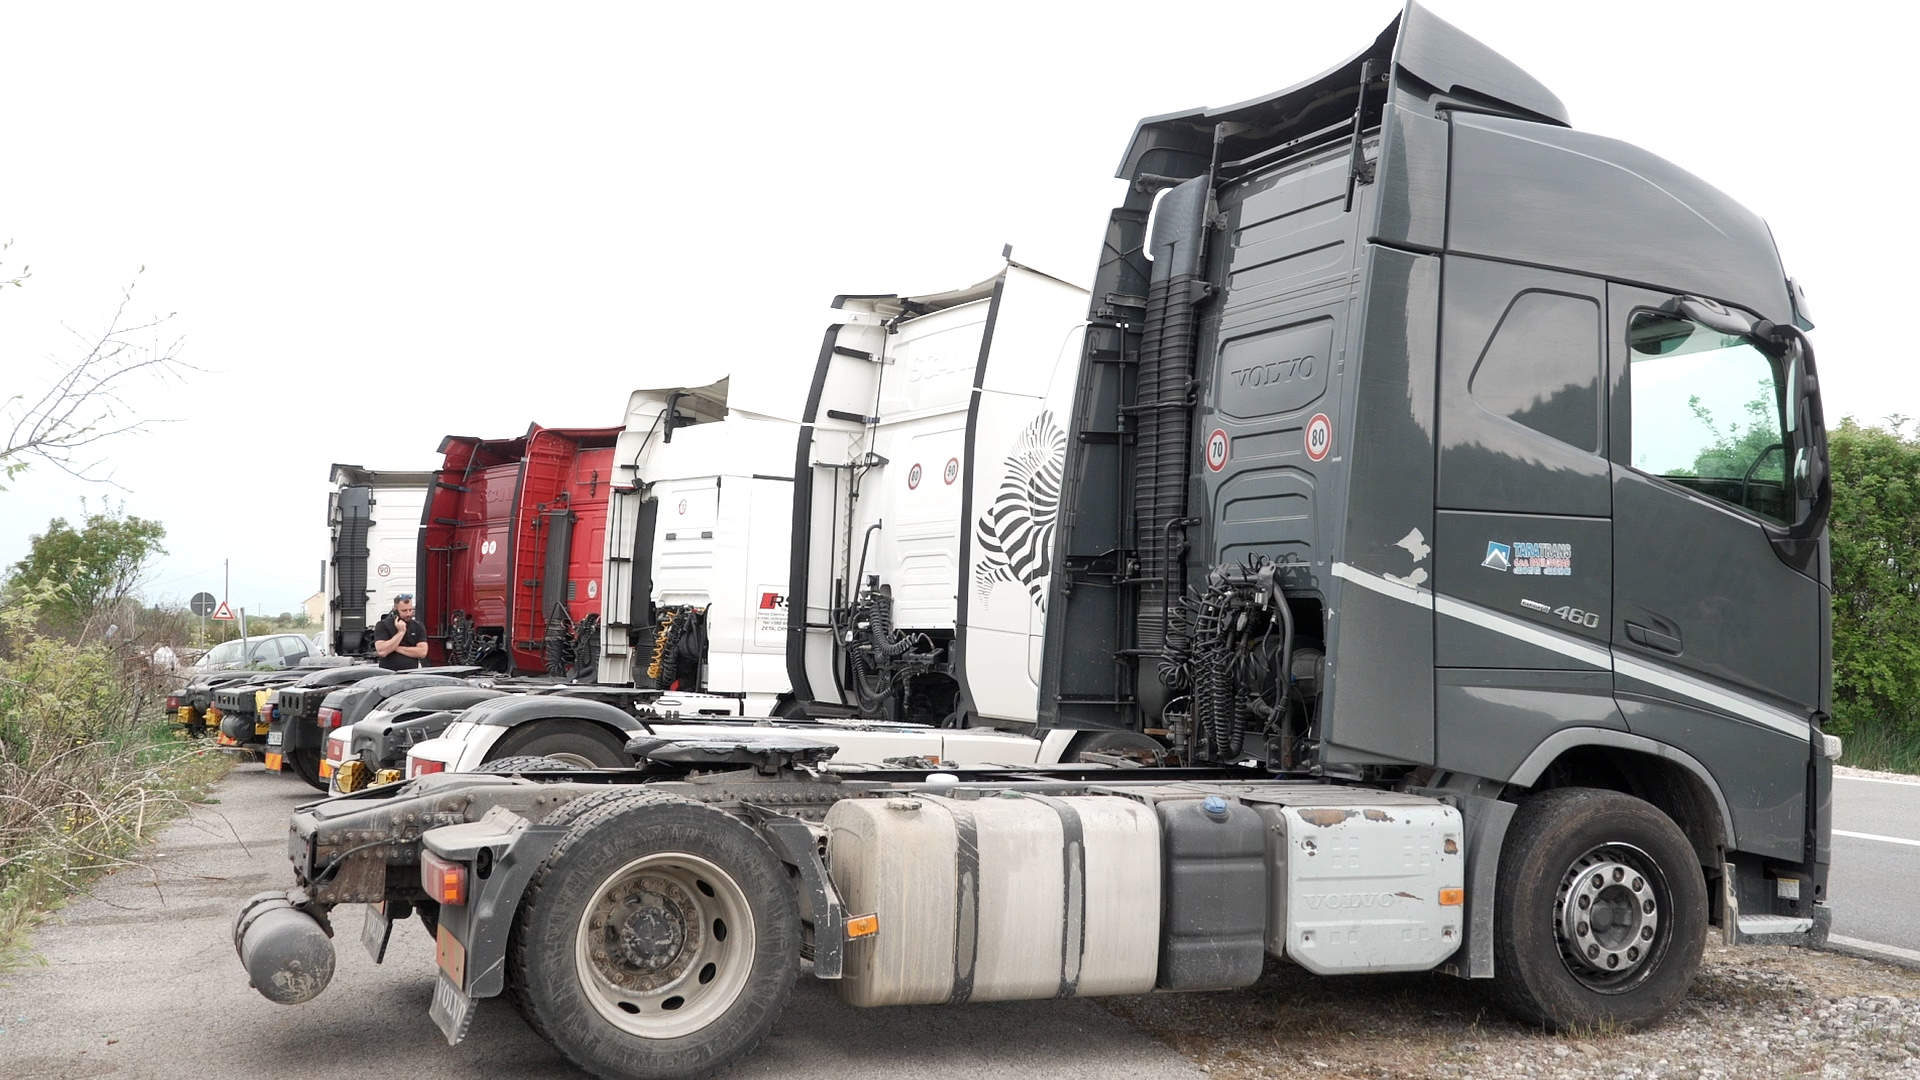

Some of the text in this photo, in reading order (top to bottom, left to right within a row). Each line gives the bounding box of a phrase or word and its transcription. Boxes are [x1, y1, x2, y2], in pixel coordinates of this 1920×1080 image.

[1231, 355, 1316, 392] VOLVO
[1311, 428, 1325, 447] 80
[1212, 441, 1223, 459] 70
[1513, 542, 1571, 559] TARATRANS
[1553, 605, 1600, 629] 460
[1303, 892, 1395, 910] VOLVO
